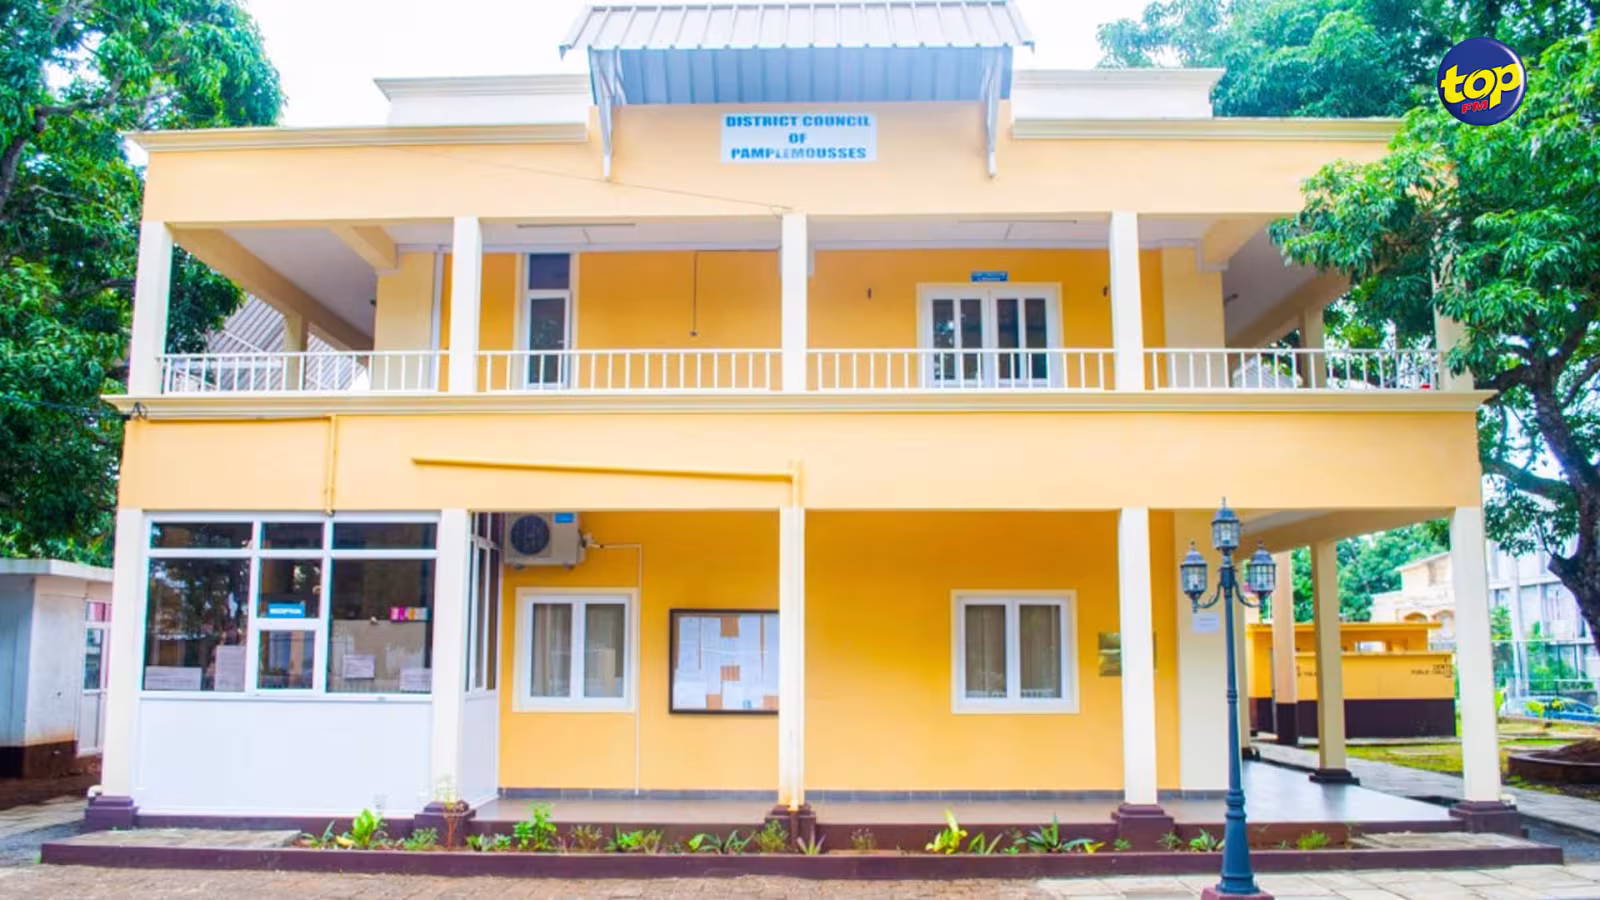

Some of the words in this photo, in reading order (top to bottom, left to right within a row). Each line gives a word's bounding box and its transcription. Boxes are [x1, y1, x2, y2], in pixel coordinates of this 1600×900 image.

[726, 115, 797, 127] DISTRICT
[802, 115, 871, 127] COUNCIL
[788, 132, 807, 144] OF
[731, 147, 867, 159] PAMPLEMOUSSES
